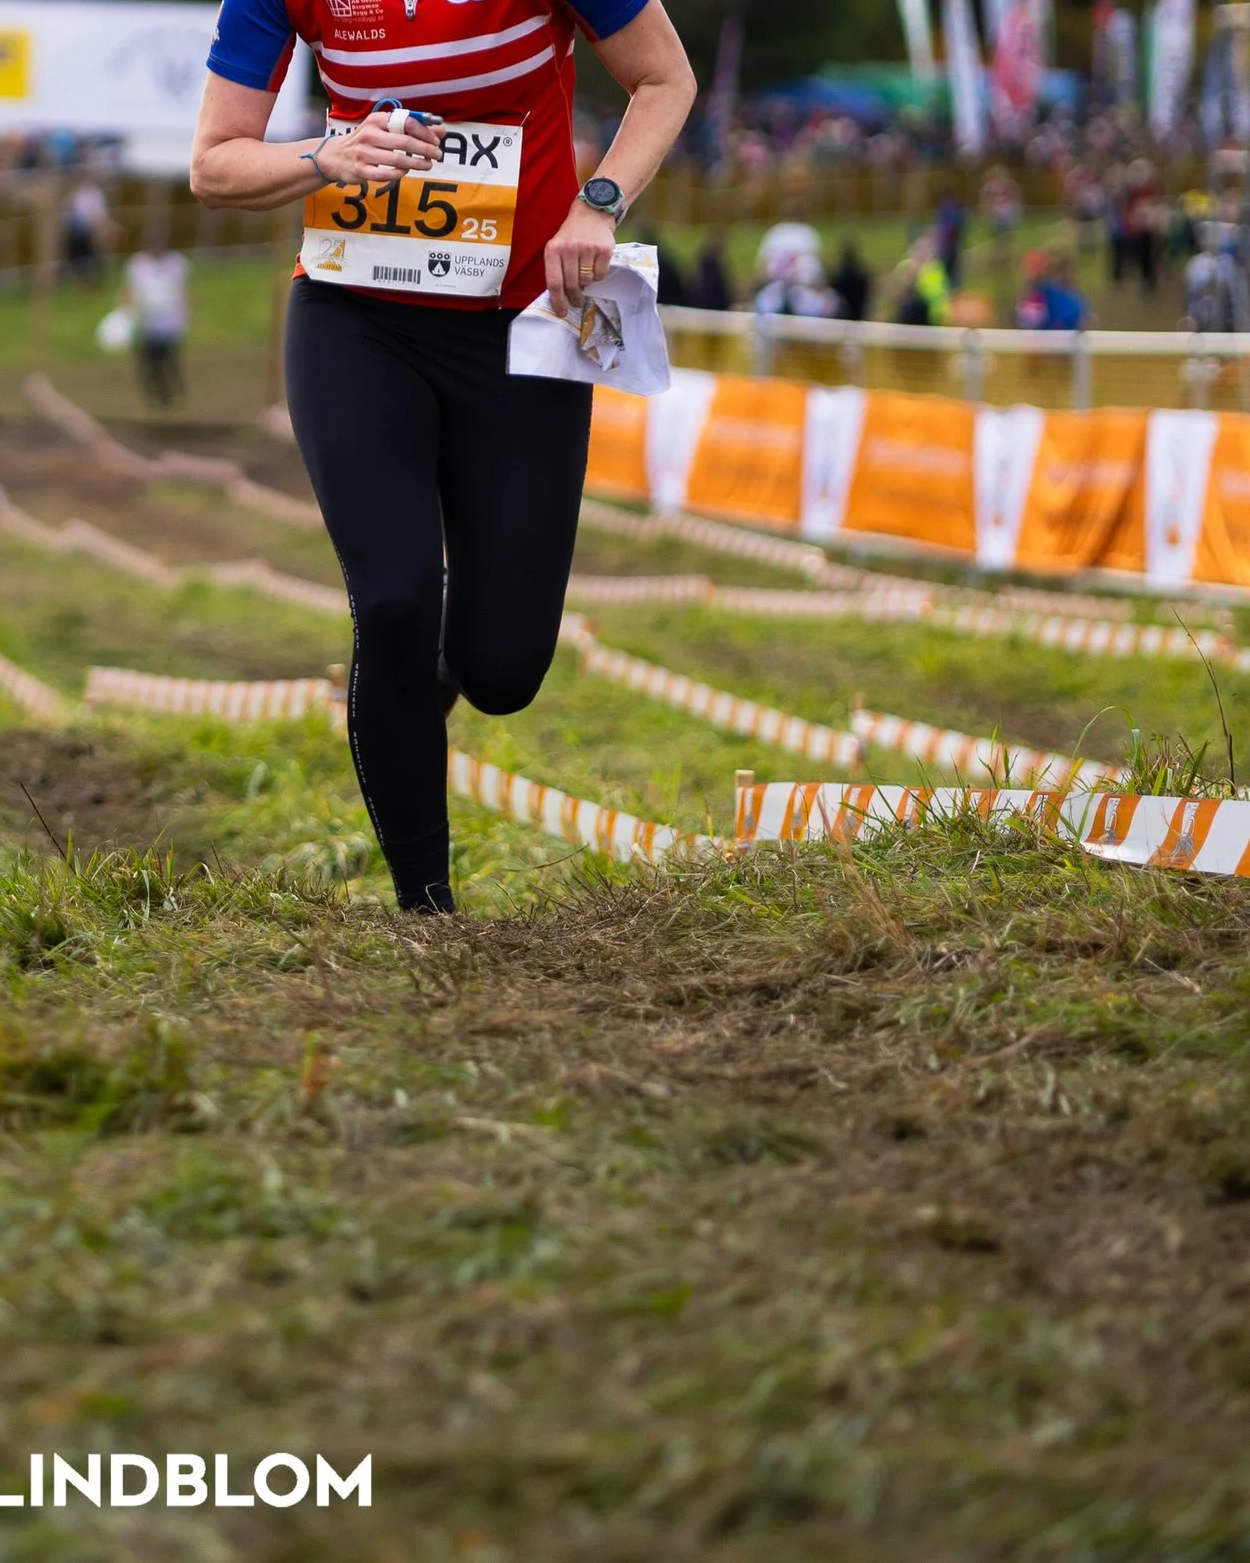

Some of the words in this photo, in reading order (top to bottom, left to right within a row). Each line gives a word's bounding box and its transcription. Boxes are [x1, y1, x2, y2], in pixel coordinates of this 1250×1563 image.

[334, 28, 386, 41] ALEWALDS
[331, 178, 458, 237] 315
[461, 217, 498, 241] 25
[454, 255, 505, 268] UPPLANDS
[454, 266, 486, 278] VÄSBY
